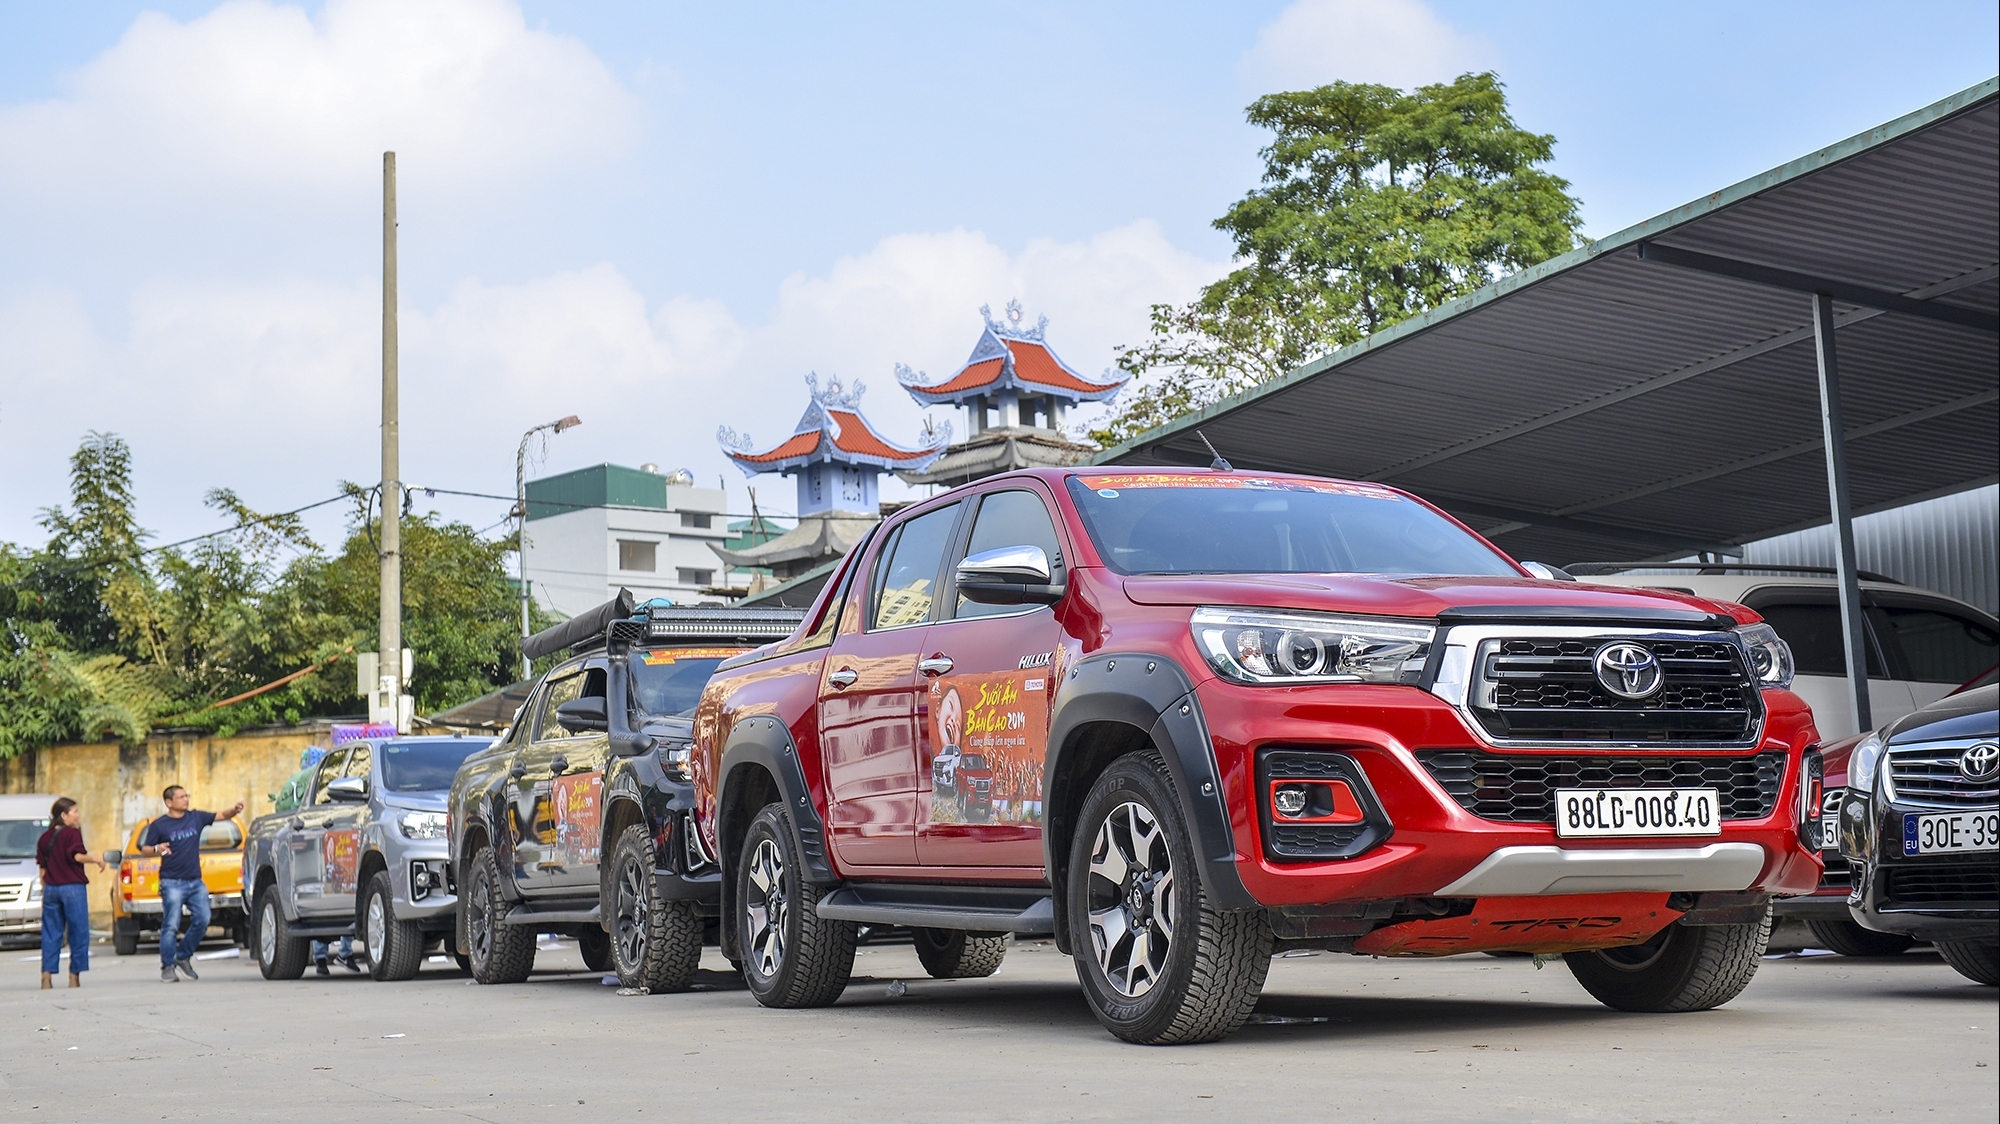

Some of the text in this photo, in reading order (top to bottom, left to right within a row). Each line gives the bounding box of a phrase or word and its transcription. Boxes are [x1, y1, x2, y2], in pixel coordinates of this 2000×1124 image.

[1018, 651, 1054, 669] HILUX
[1568, 796, 1710, 828] 88LD-008.40
[1905, 840, 1918, 849] EU
[1489, 916, 1622, 932] TRD
